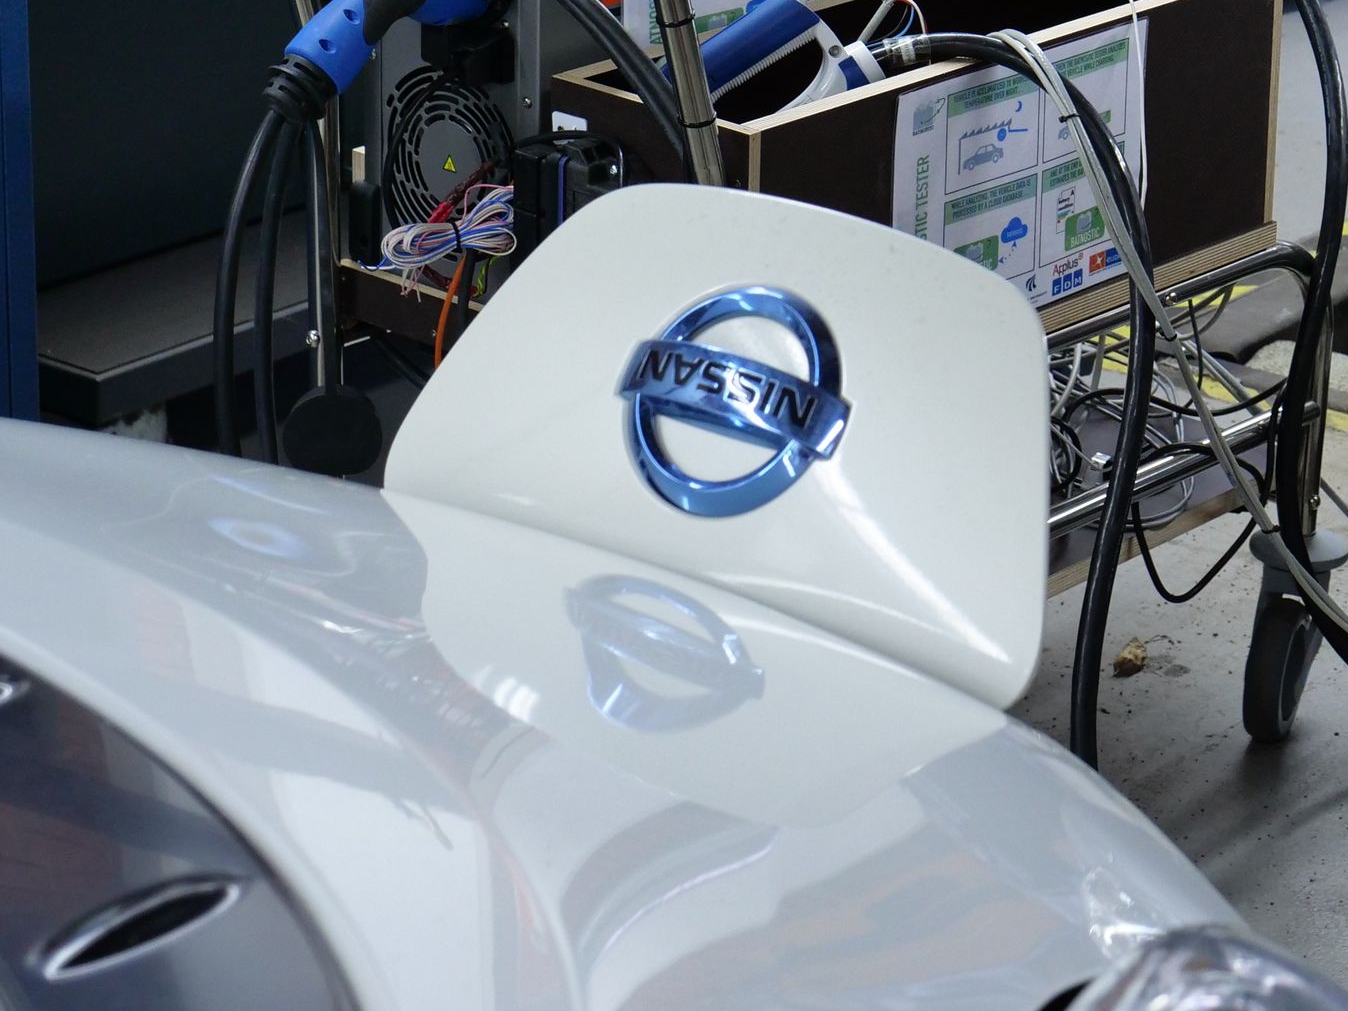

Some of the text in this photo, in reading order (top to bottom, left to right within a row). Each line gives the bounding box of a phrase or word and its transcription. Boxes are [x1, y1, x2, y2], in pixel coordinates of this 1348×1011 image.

[915, 155, 930, 210] TESTER
[1070, 227, 1100, 248] BATNOSTIC
[1053, 259, 1079, 277] Applus
[635, 348, 818, 431] NISSAN
